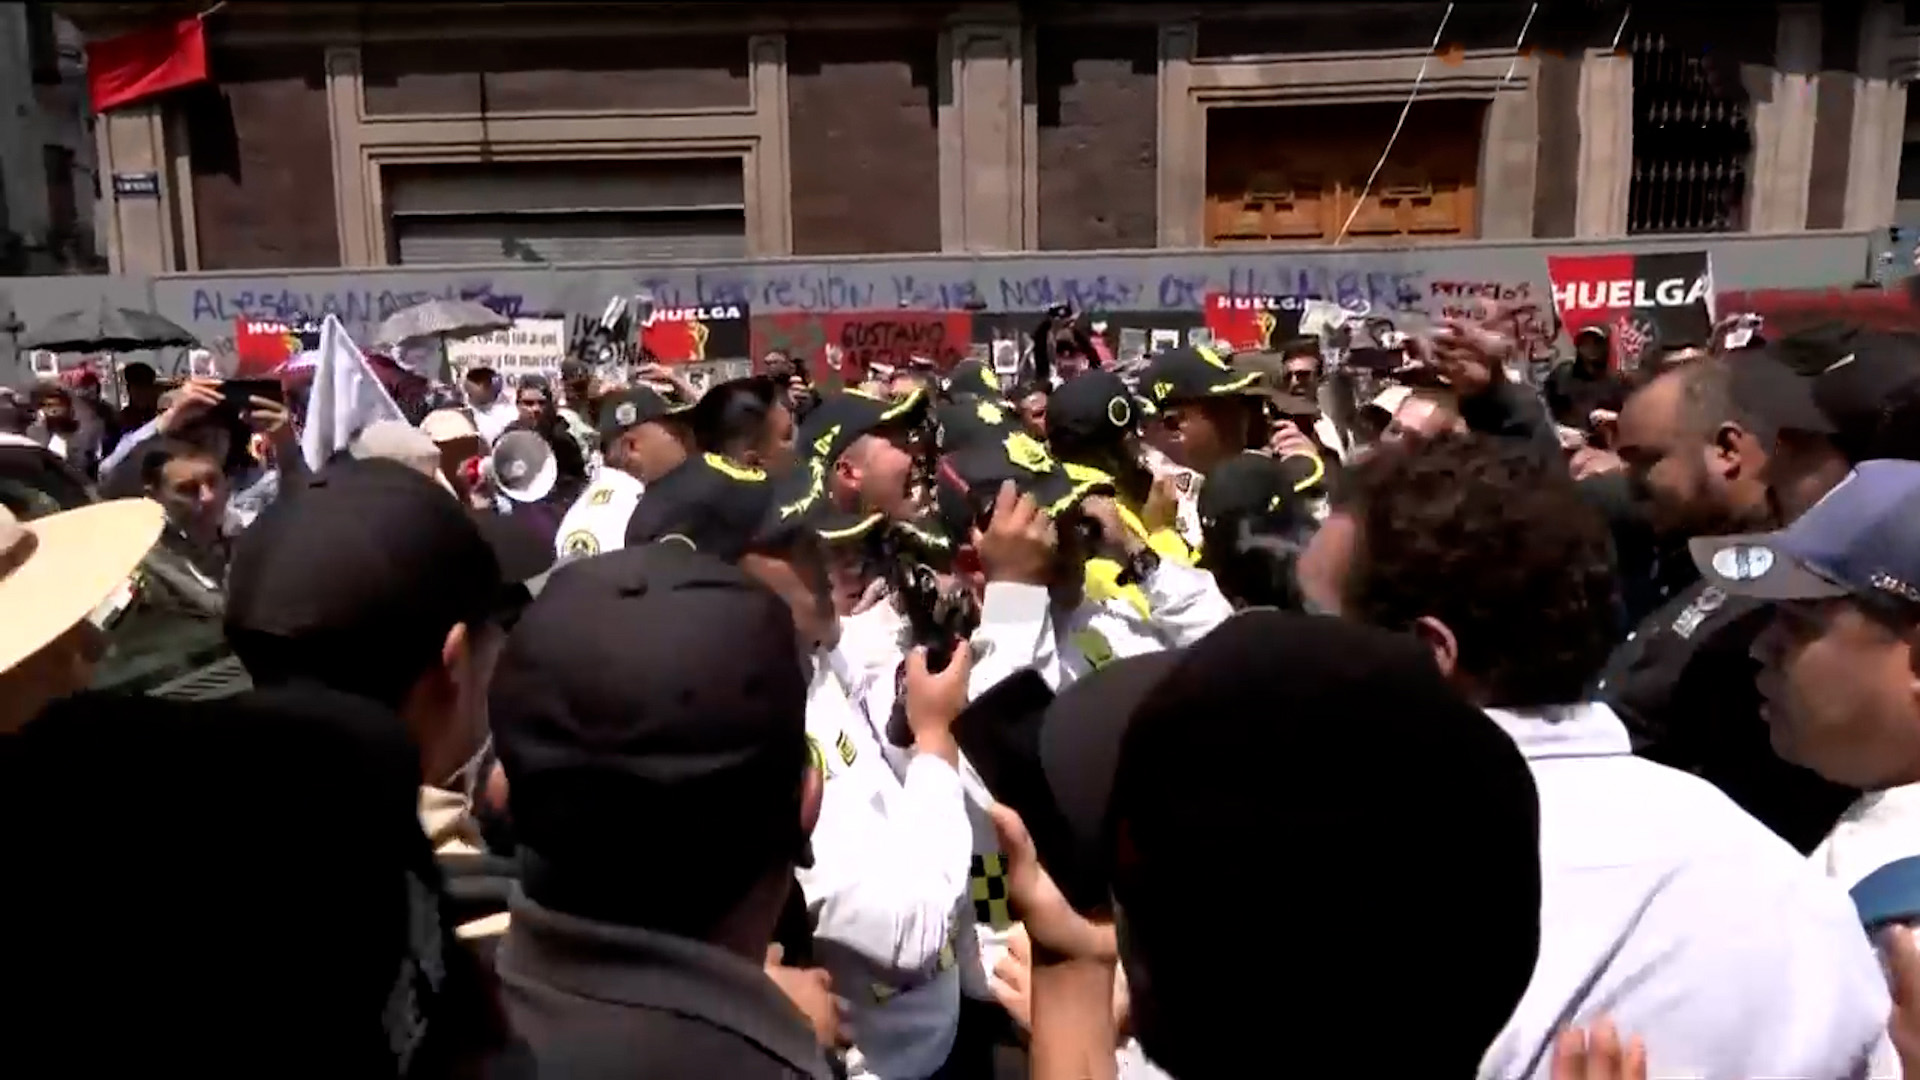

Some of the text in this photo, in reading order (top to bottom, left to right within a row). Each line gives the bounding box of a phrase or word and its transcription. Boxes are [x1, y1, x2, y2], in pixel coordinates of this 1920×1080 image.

[1551, 274, 1708, 311] HUELGA
[1217, 296, 1302, 310] HUELG
[650, 306, 741, 321] HUELGA
